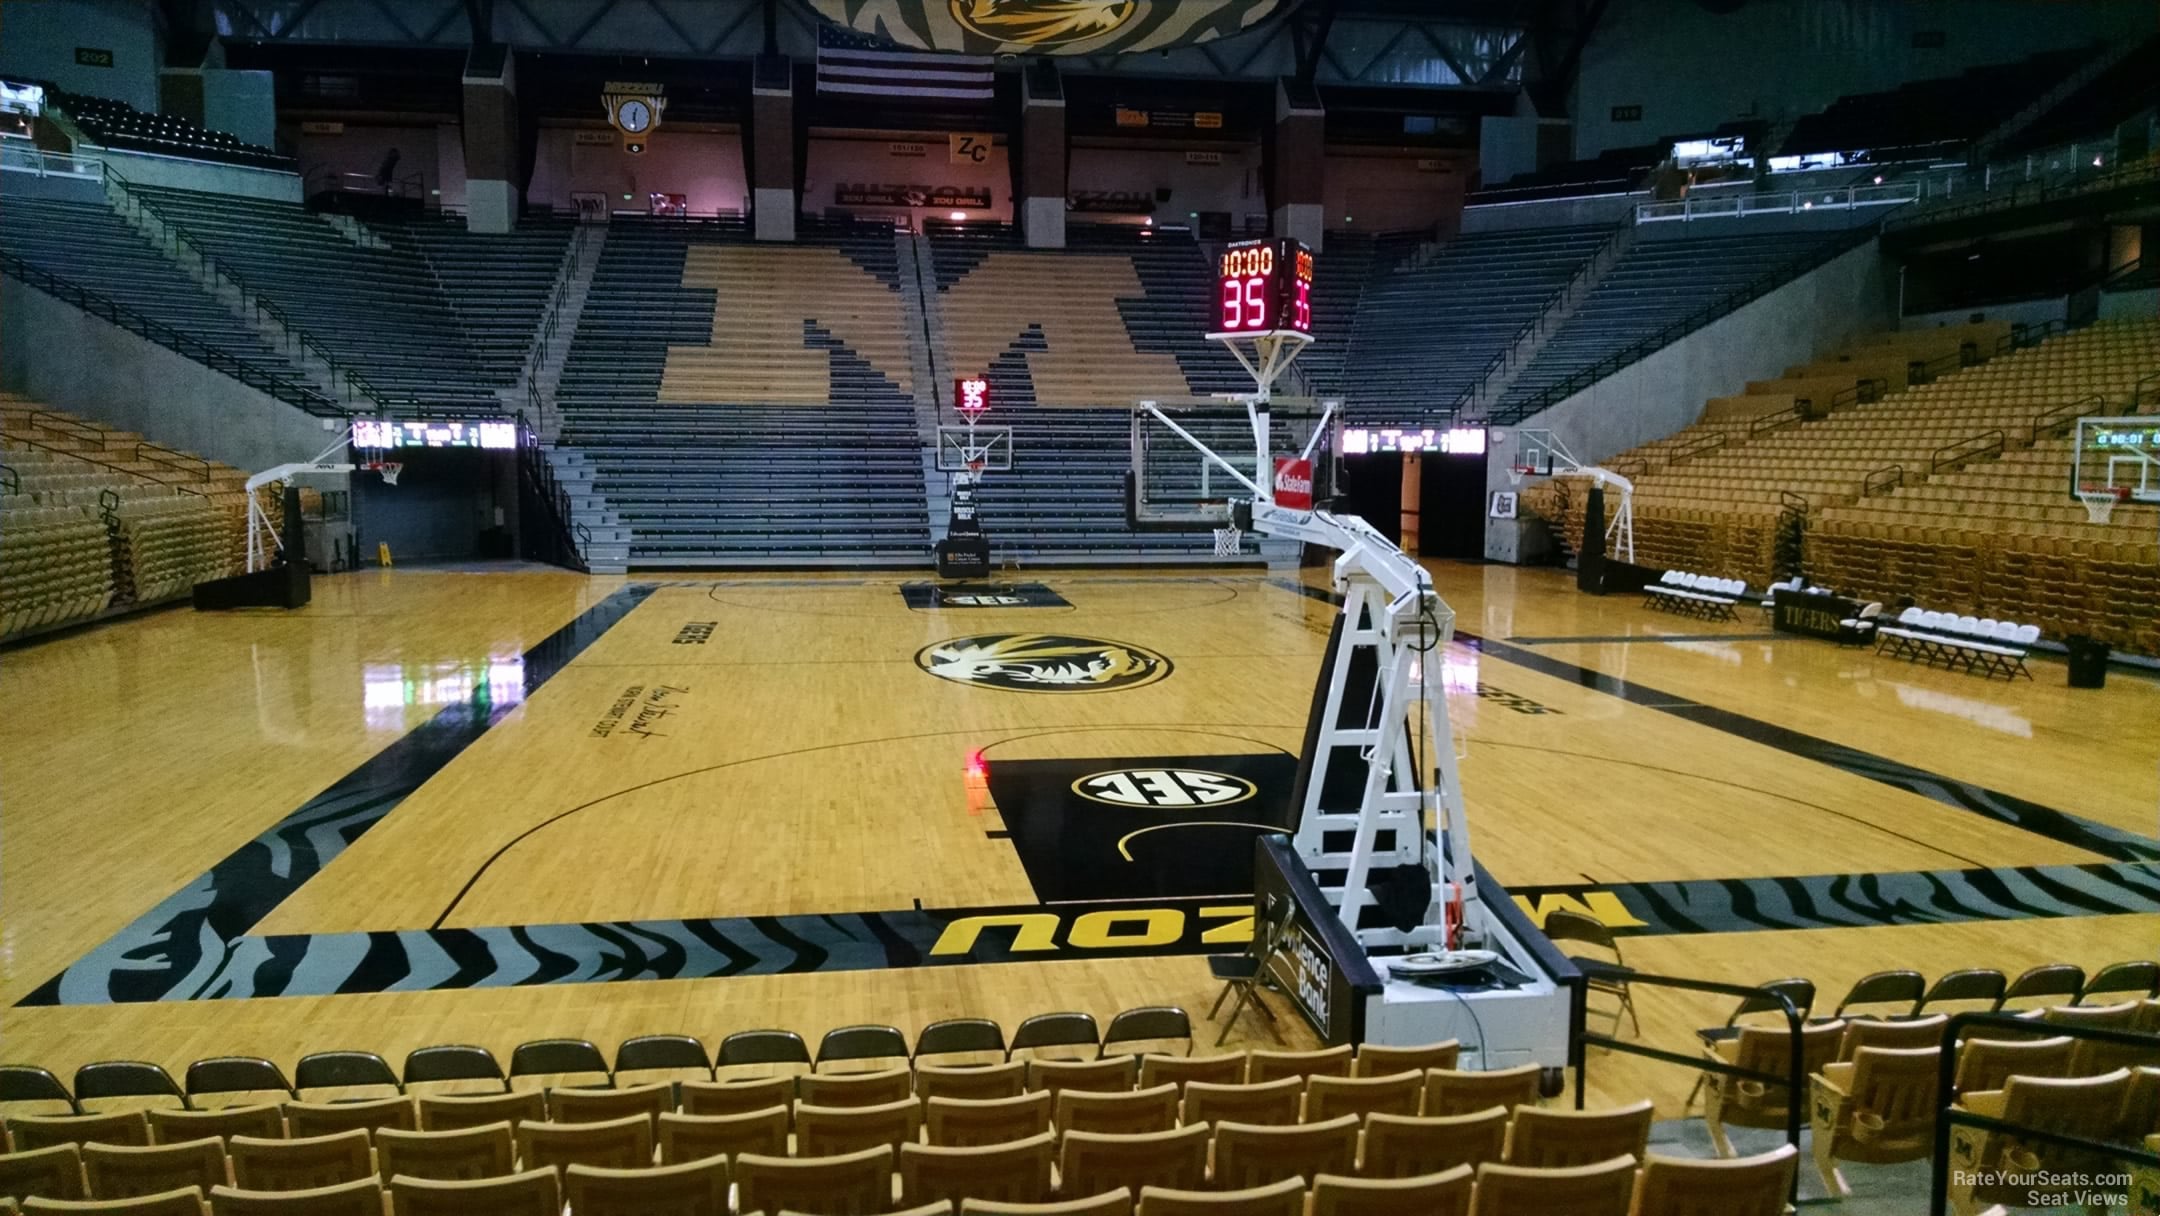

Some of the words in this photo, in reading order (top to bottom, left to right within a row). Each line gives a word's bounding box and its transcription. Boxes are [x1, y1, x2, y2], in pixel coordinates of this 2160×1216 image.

[1224, 247, 1272, 277] 10:00
[1224, 278, 1264, 328] 35
[963, 391, 983, 408] 35
[671, 621, 719, 645] TIGERS
[1784, 606, 1840, 632] TIGERS
[1088, 771, 1243, 805] SEC
[1299, 965, 1330, 1025] Bank
